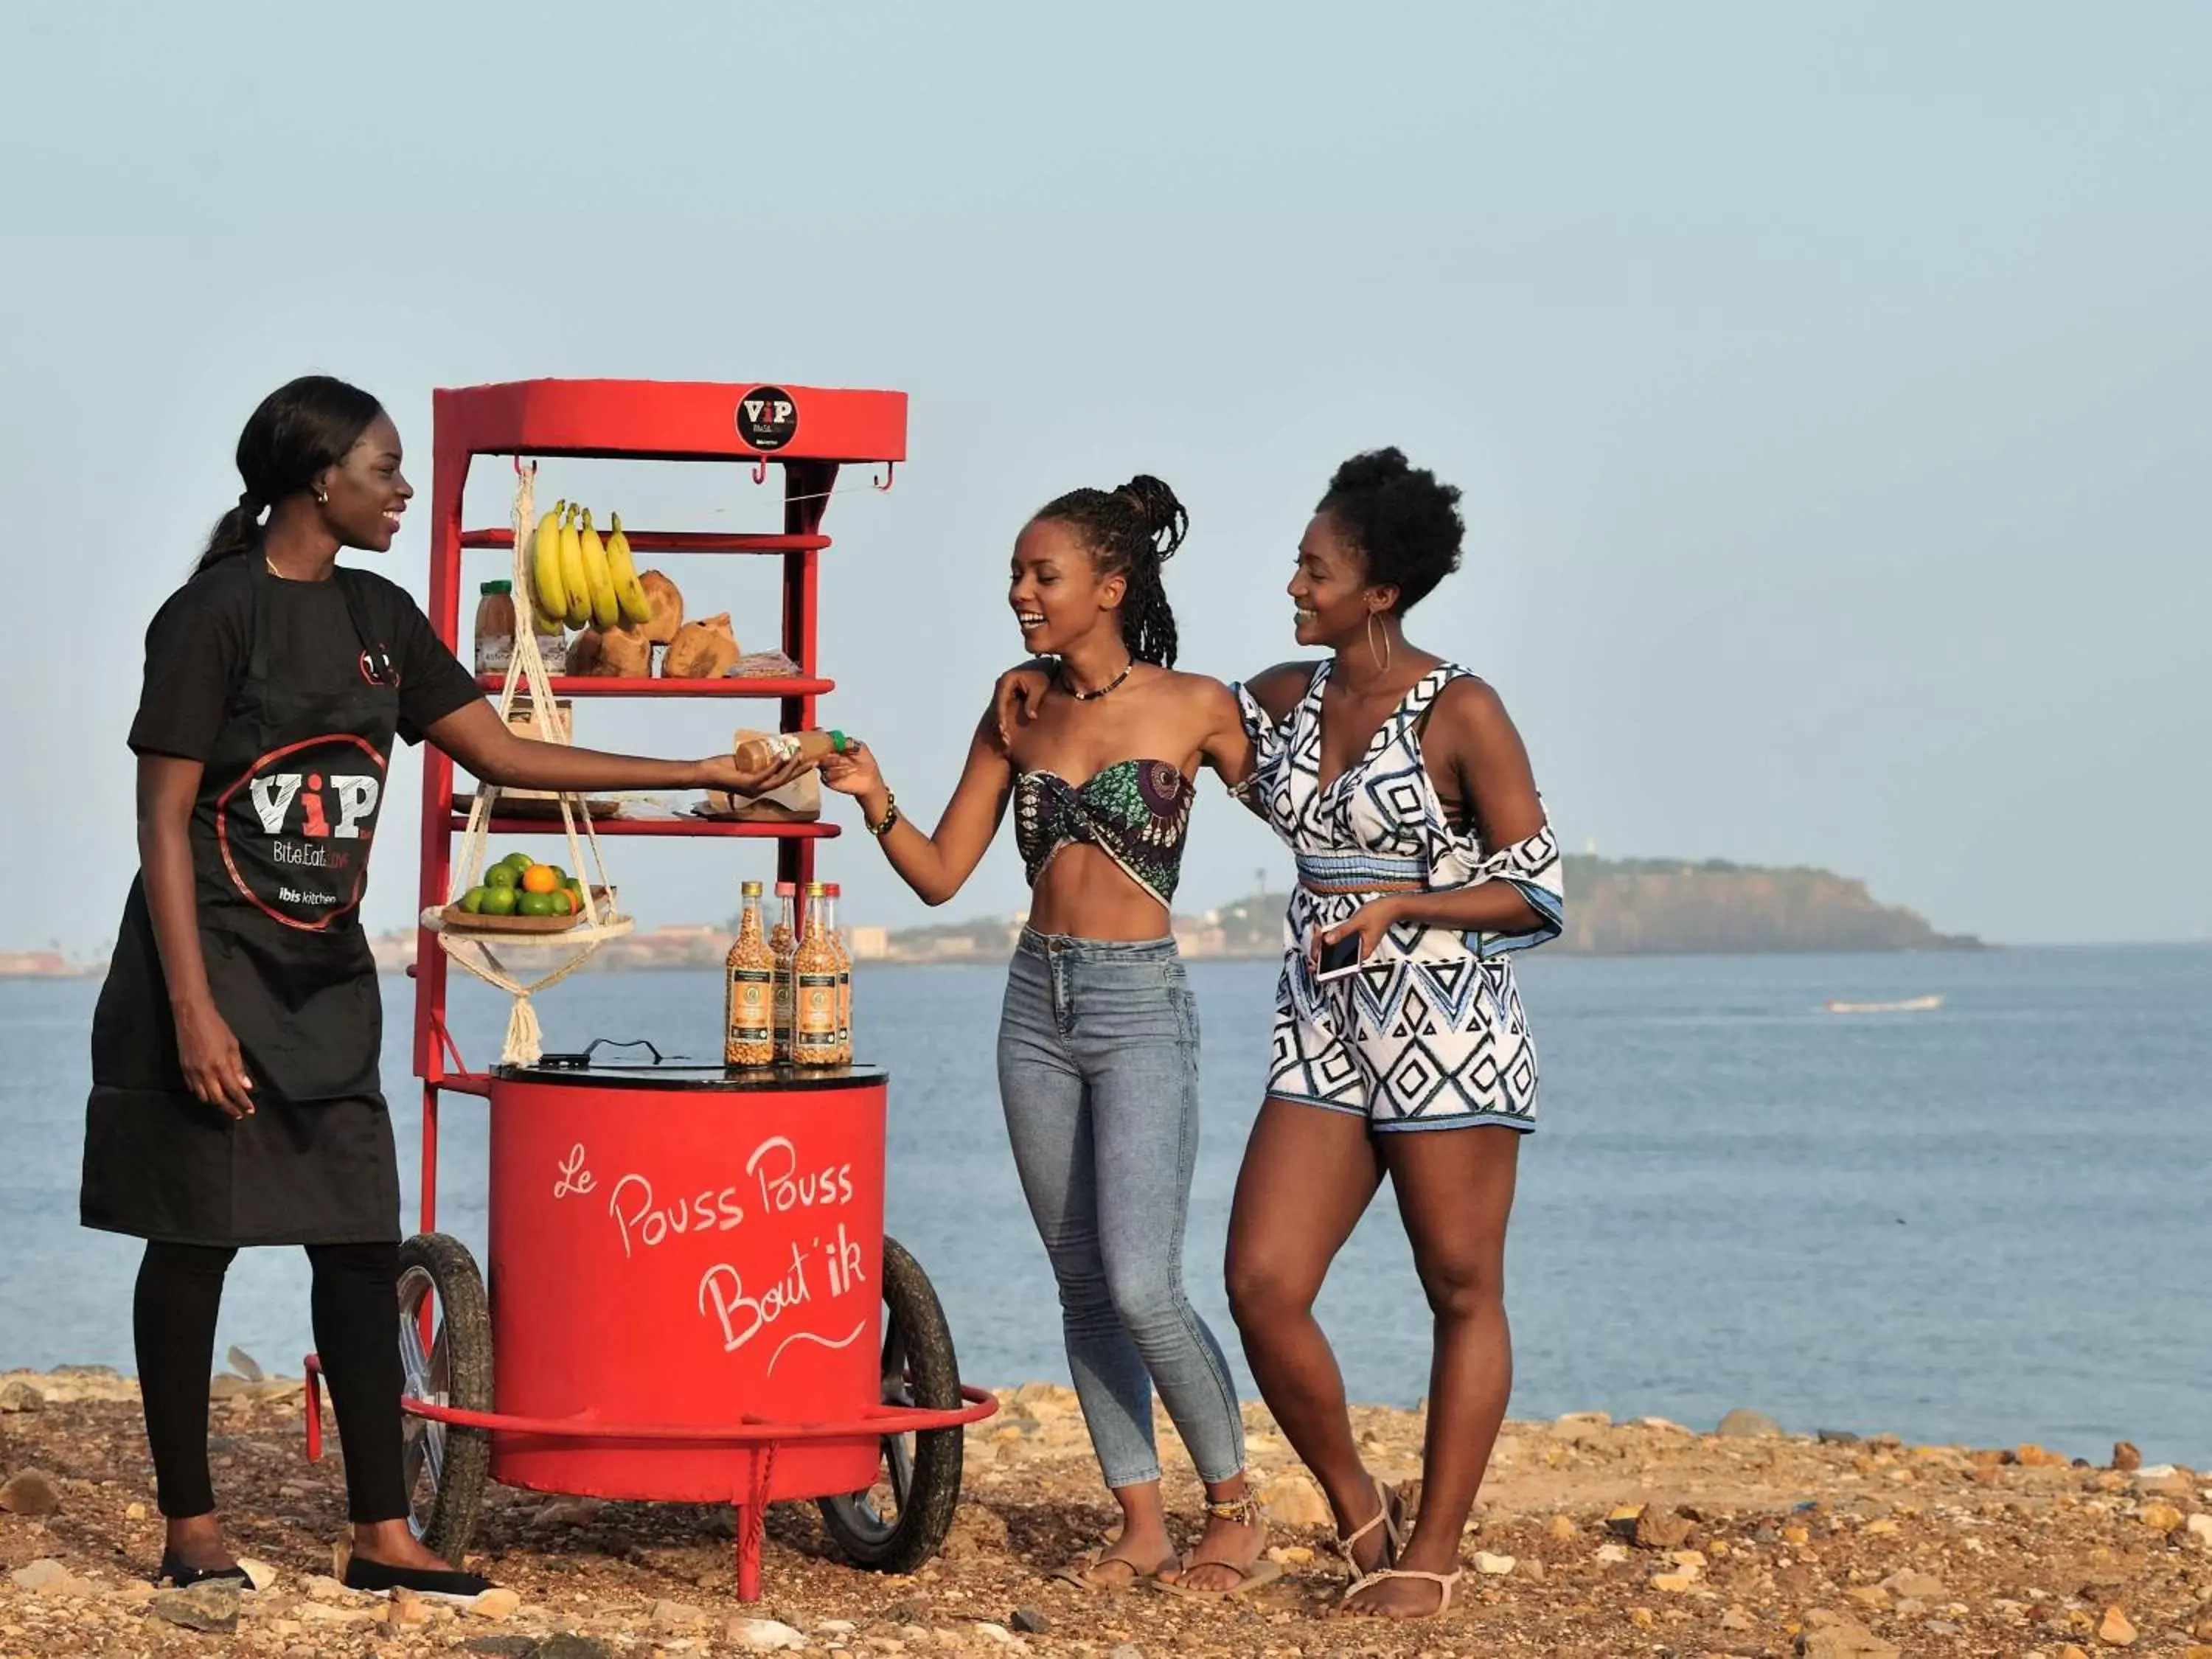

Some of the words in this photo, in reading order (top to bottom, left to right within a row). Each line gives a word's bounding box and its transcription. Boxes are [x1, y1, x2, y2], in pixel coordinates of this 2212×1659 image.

[279, 887, 301, 903] ibis
[302, 891, 336, 905] kitchen
[554, 1143, 596, 1198] Le
[609, 1173, 744, 1258] Pouss
[745, 1135, 854, 1214] Pouss
